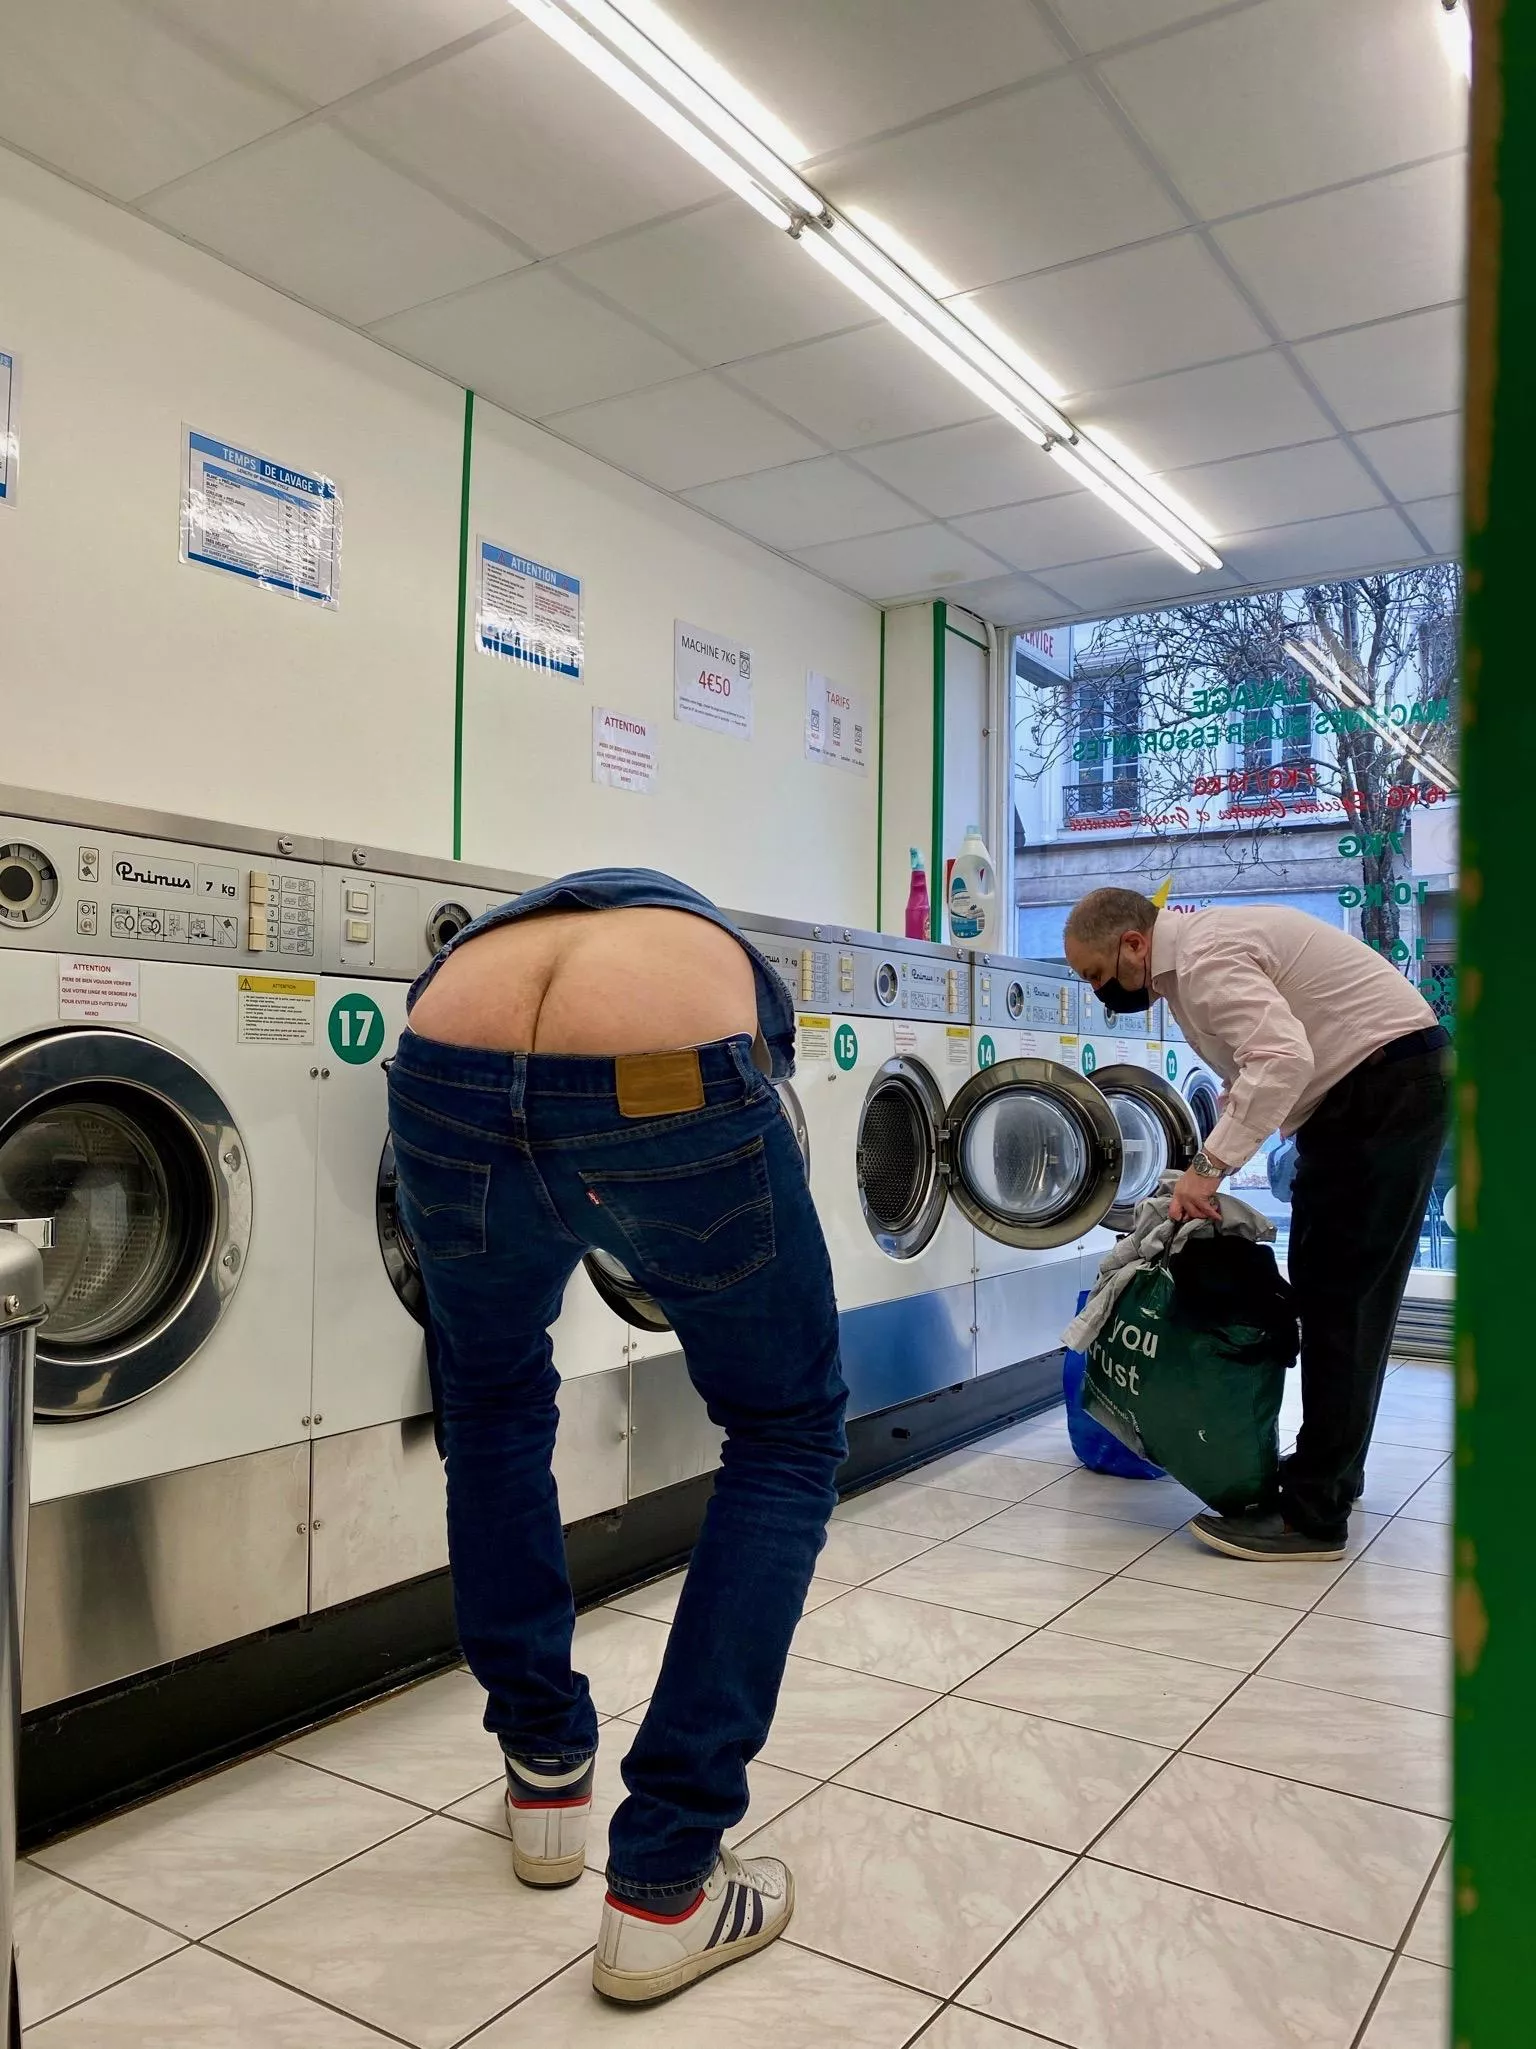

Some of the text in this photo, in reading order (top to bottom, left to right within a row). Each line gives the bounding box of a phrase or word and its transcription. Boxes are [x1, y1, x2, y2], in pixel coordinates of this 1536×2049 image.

[222, 448, 256, 470] TEMPS
[264, 464, 277, 479] DE
[279, 468, 313, 493] LAVAGE
[511, 556, 557, 585] ATTENTION
[681, 635, 736, 666] MACHINE 7KG
[698, 670, 731, 697] 4€50
[826, 690, 850, 710] TARIFS
[604, 716, 646, 736] ATTENTION
[116, 861, 236, 897] Primus 7 kg
[270, 894, 275, 902] 2
[270, 909, 275, 918] 3
[269, 925, 275, 933] 4
[73, 963, 112, 973] ATTENTION
[911, 968, 933, 982] Primus
[338, 1010, 375, 1047] 17
[839, 1034, 854, 1058] 15
[980, 1044, 992, 1064] 14
[1084, 1052, 1094, 1070] 13
[1168, 1058, 1175, 1074] 12
[1107, 1314, 1158, 1358] you
